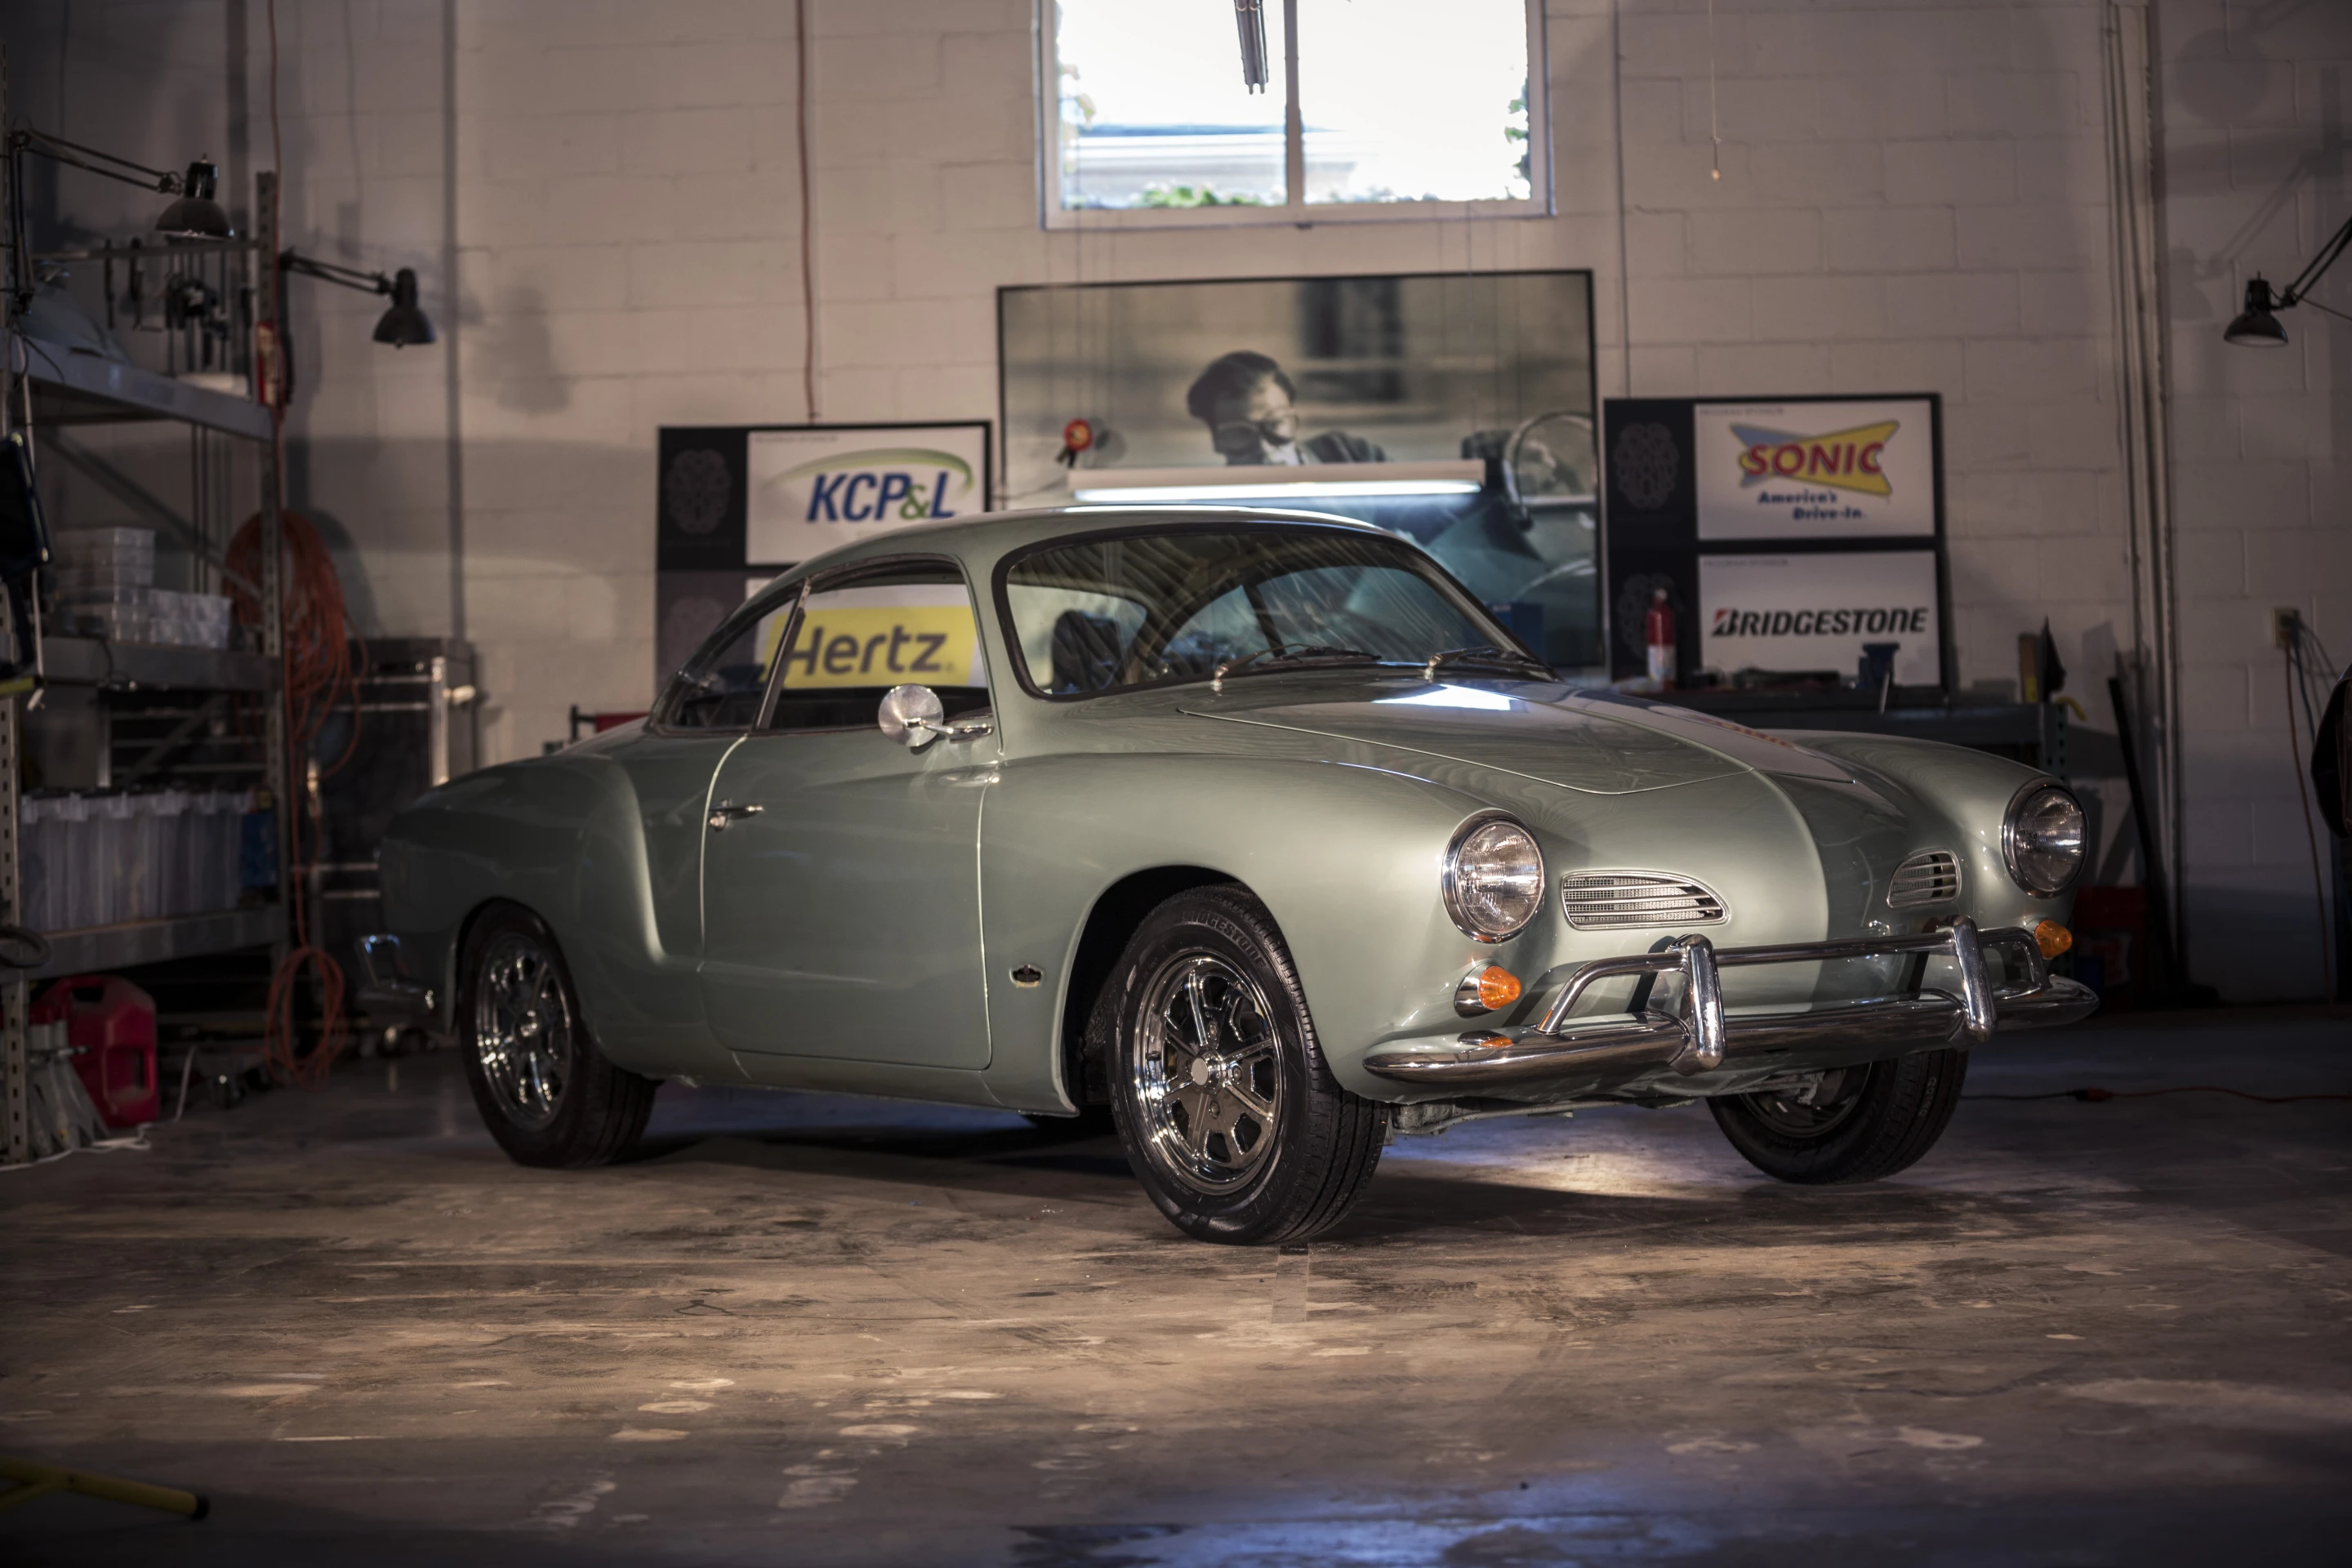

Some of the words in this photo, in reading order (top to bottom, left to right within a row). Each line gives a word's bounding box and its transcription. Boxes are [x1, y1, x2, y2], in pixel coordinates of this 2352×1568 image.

[1746, 442, 1885, 476] SONIC
[806, 471, 955, 523] KCP&L
[1758, 491, 1837, 504] America's
[1793, 507, 1863, 520] Drive-In
[1713, 608, 1928, 636] BRIDGESTONE
[787, 624, 948, 676] Hertz
